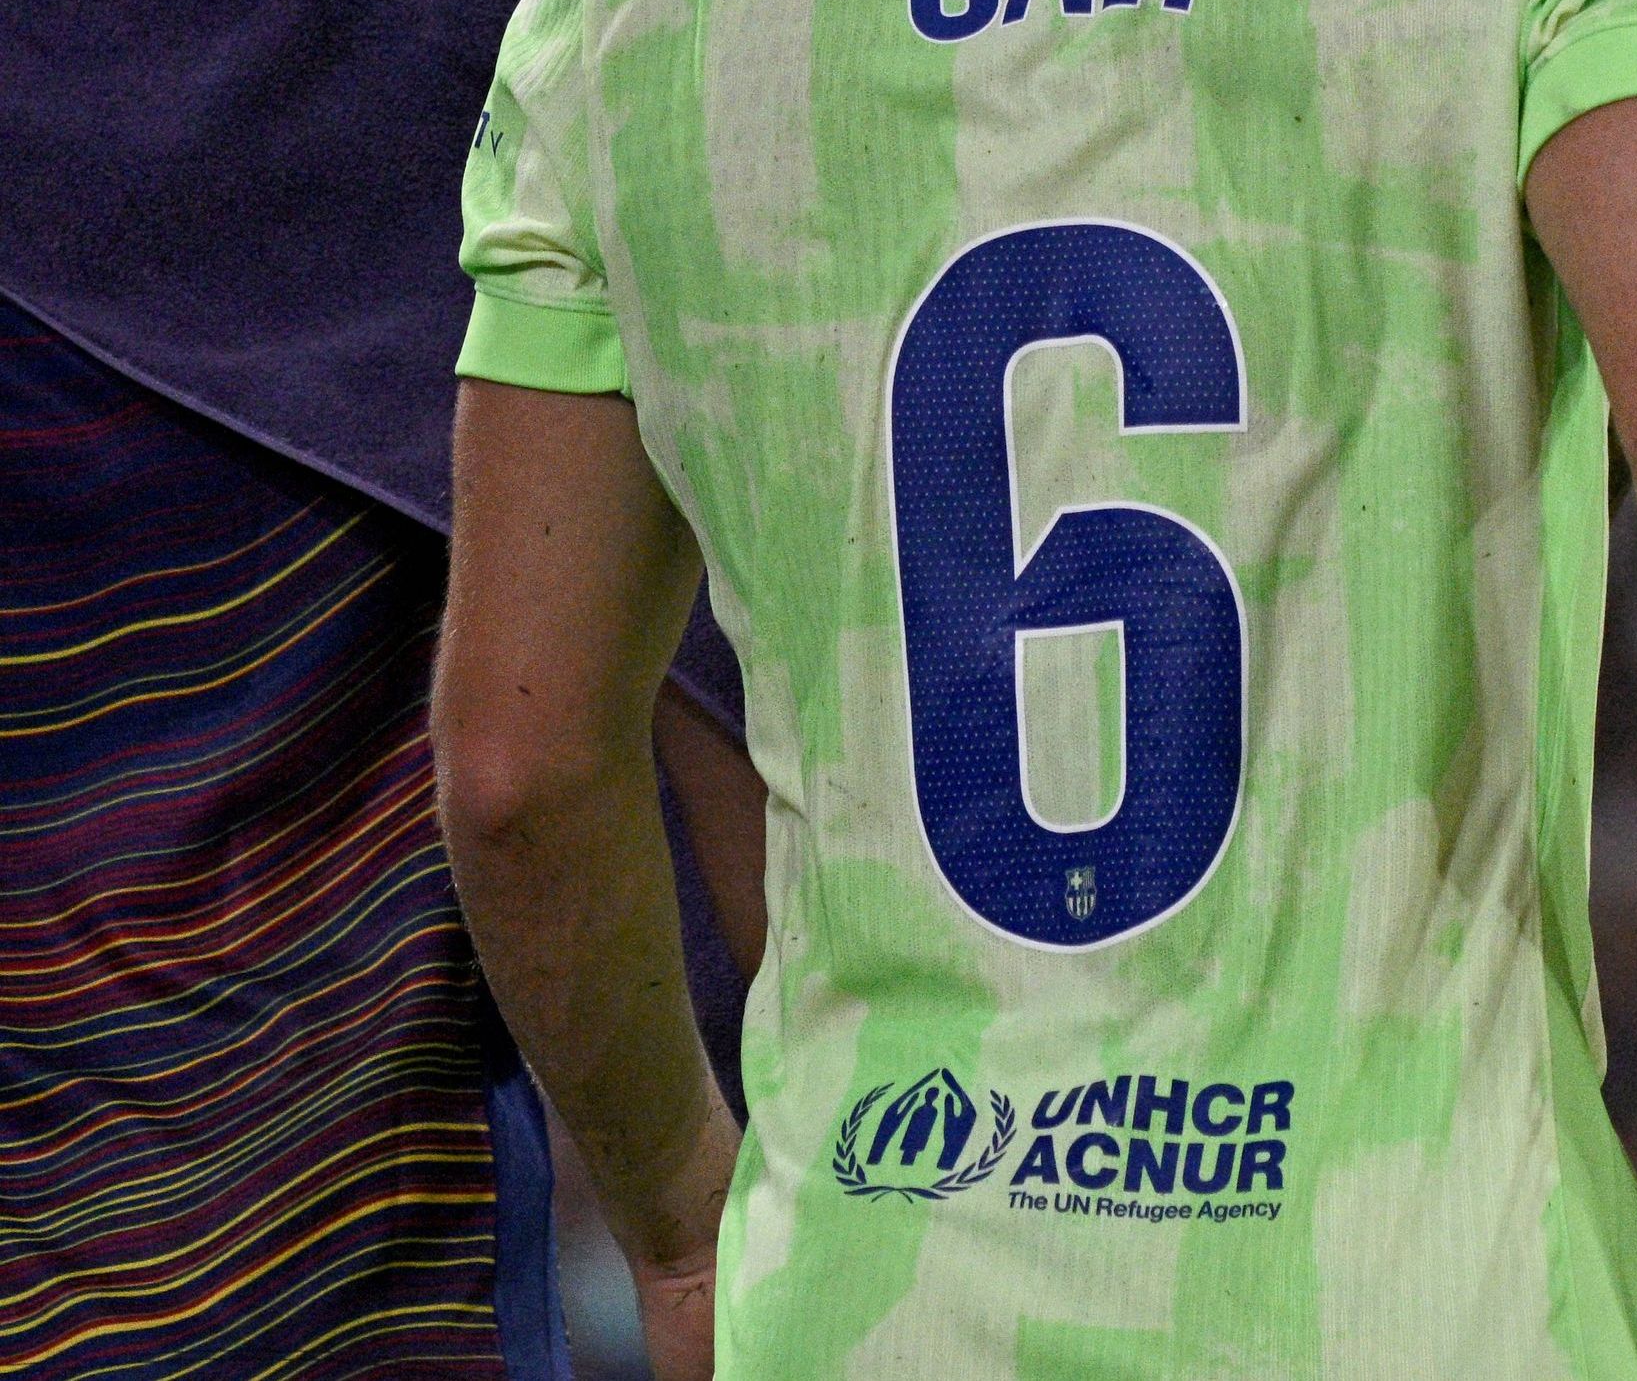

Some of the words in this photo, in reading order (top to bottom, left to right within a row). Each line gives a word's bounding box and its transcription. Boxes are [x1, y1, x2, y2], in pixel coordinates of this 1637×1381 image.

[886, 217, 1249, 955] 6
[1031, 1074, 1296, 1137] UNHCR
[1008, 1132, 1288, 1196] ACNUR
[1008, 1191, 1048, 1211] The
[1054, 1192, 1091, 1215] UN
[1095, 1197, 1193, 1223] Refugee
[1197, 1200, 1283, 1223] Agency
